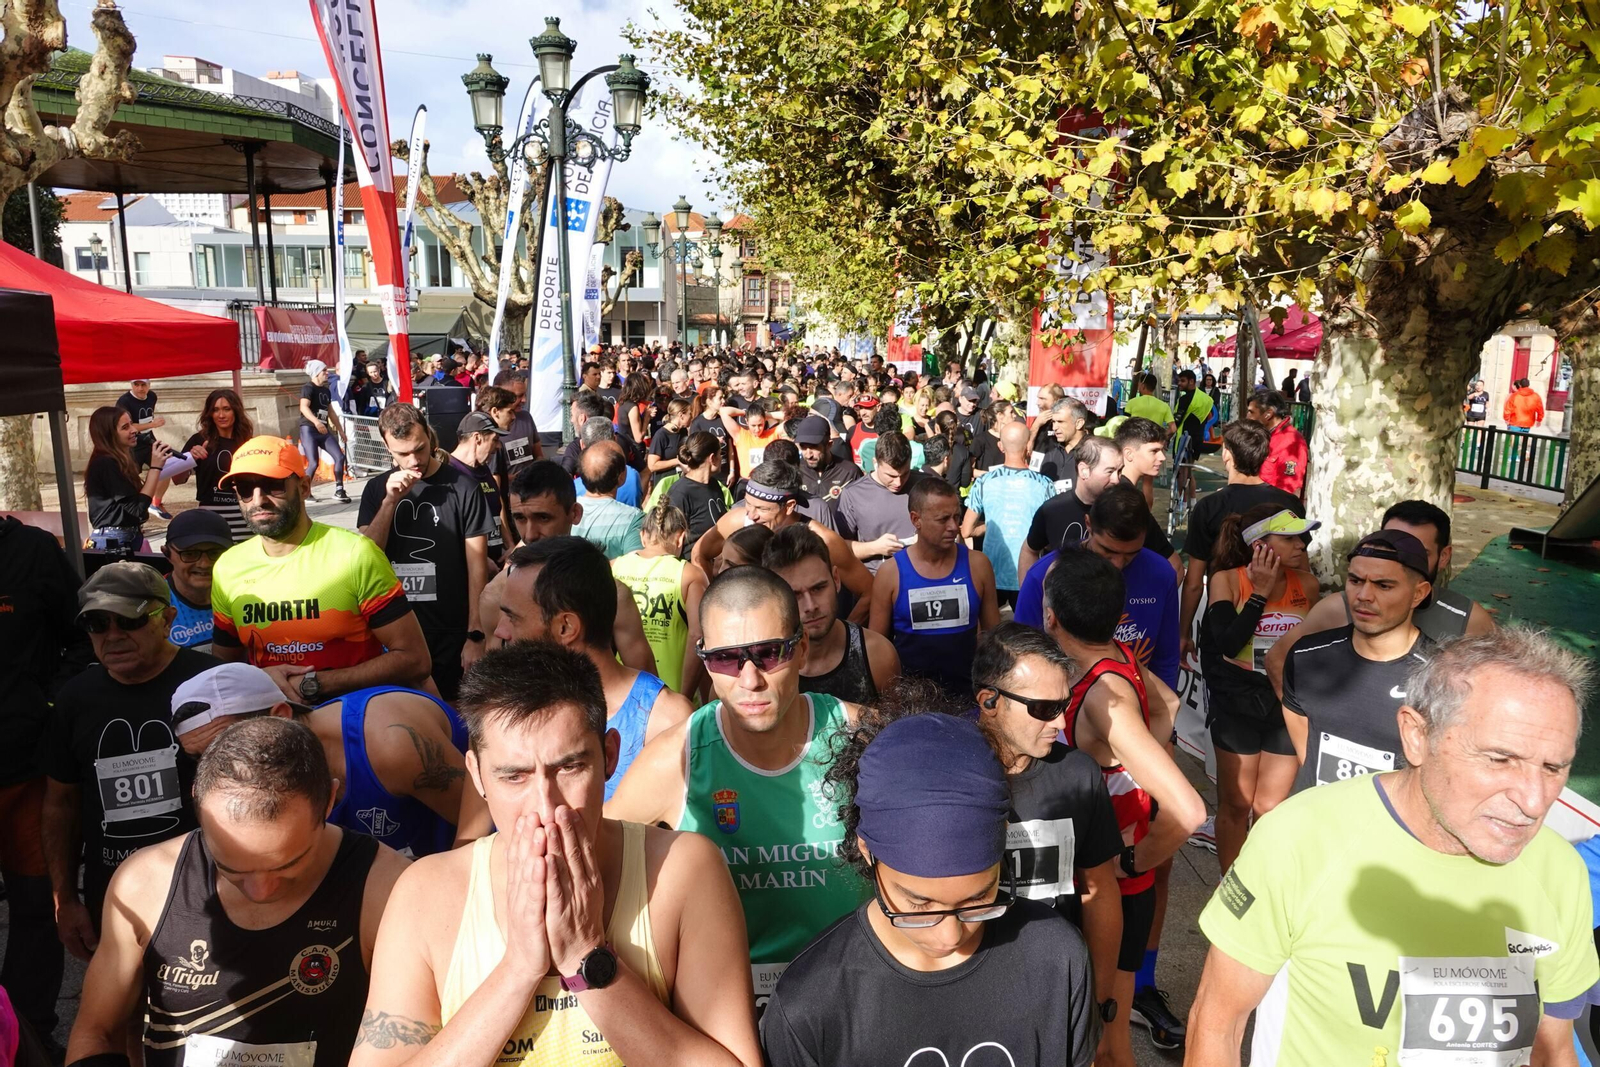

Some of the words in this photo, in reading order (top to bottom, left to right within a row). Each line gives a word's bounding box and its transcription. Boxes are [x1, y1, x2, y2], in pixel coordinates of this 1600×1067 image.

[575, 171, 593, 195] DE
[540, 256, 559, 330] DEPORTE
[513, 446, 525, 457] 50
[402, 576, 426, 591] 617
[1129, 597, 1157, 605] OYSHO
[243, 598, 320, 624] 3NORTH
[925, 600, 942, 617] 19
[651, 617, 670, 627] máis
[266, 641, 324, 655] Gasóleos
[268, 652, 305, 664] Amigo
[122, 757, 156, 768] MÓVOME
[114, 771, 164, 803] 801
[102, 847, 114, 860] EU
[738, 865, 827, 890] MARÍN
[307, 920, 337, 928] AMURA
[301, 946, 330, 957] C.A.R.
[156, 963, 169, 981] El
[171, 966, 221, 991] Trigal
[290, 963, 339, 994] MARISQUEIRO
[760, 973, 771, 982] EU
[1433, 967, 1448, 978] EU
[1450, 965, 1508, 979] MÓVOME
[1428, 997, 1519, 1043] 695
[215, 1048, 229, 1060] EU
[229, 1050, 285, 1063] MÓVOME
[582, 1046, 612, 1055] CLÍNICAS
